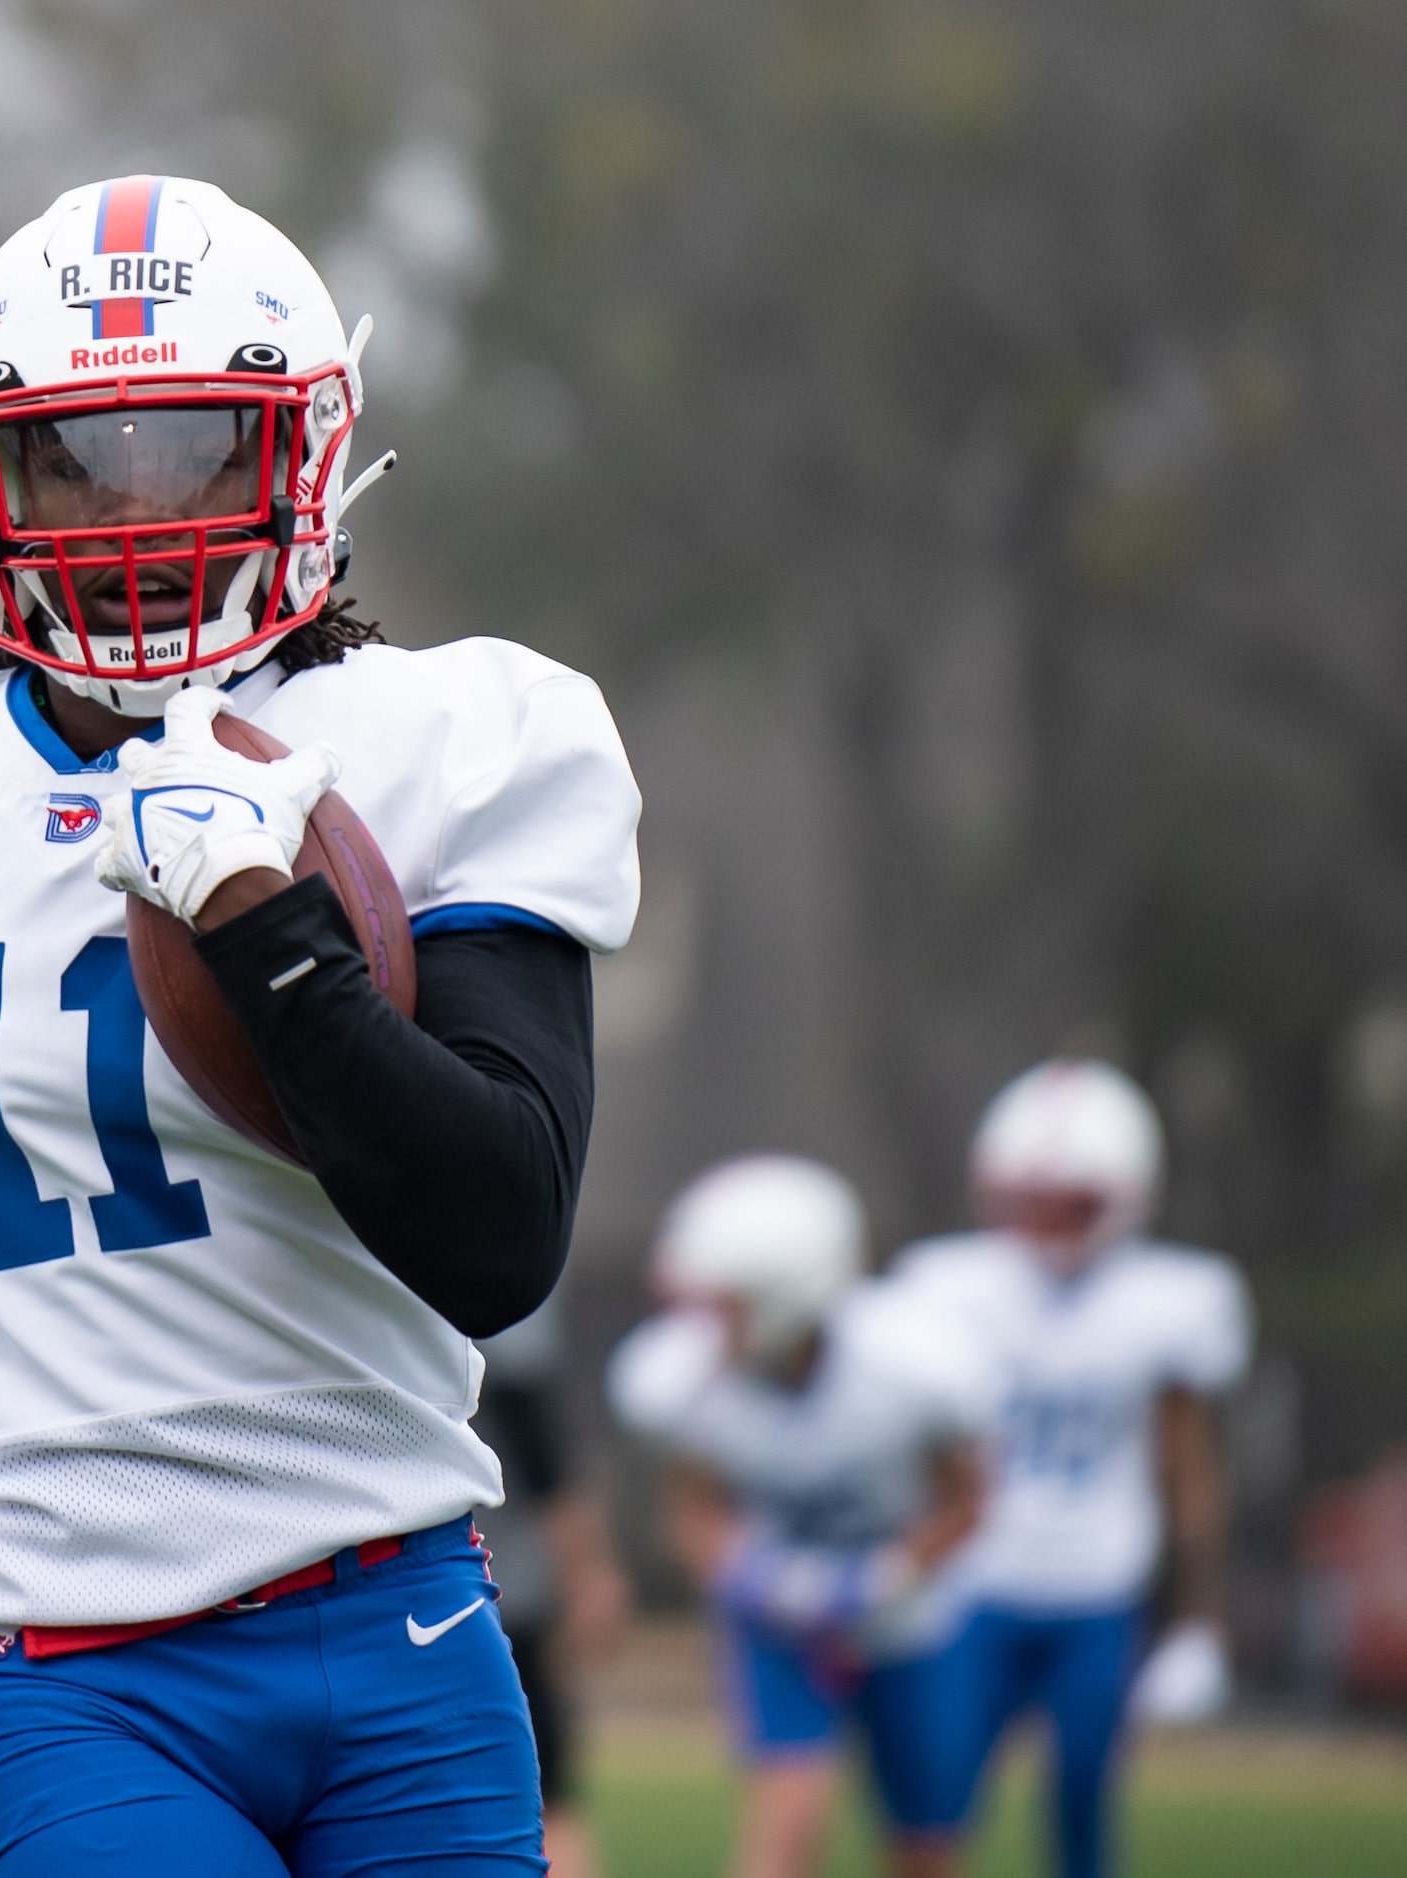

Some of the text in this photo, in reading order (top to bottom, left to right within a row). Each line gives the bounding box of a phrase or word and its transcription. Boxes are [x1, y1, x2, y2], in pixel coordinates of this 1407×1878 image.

[61, 258, 193, 300] R. RICE
[256, 291, 288, 320] SMU
[71, 342, 177, 369] Riddell
